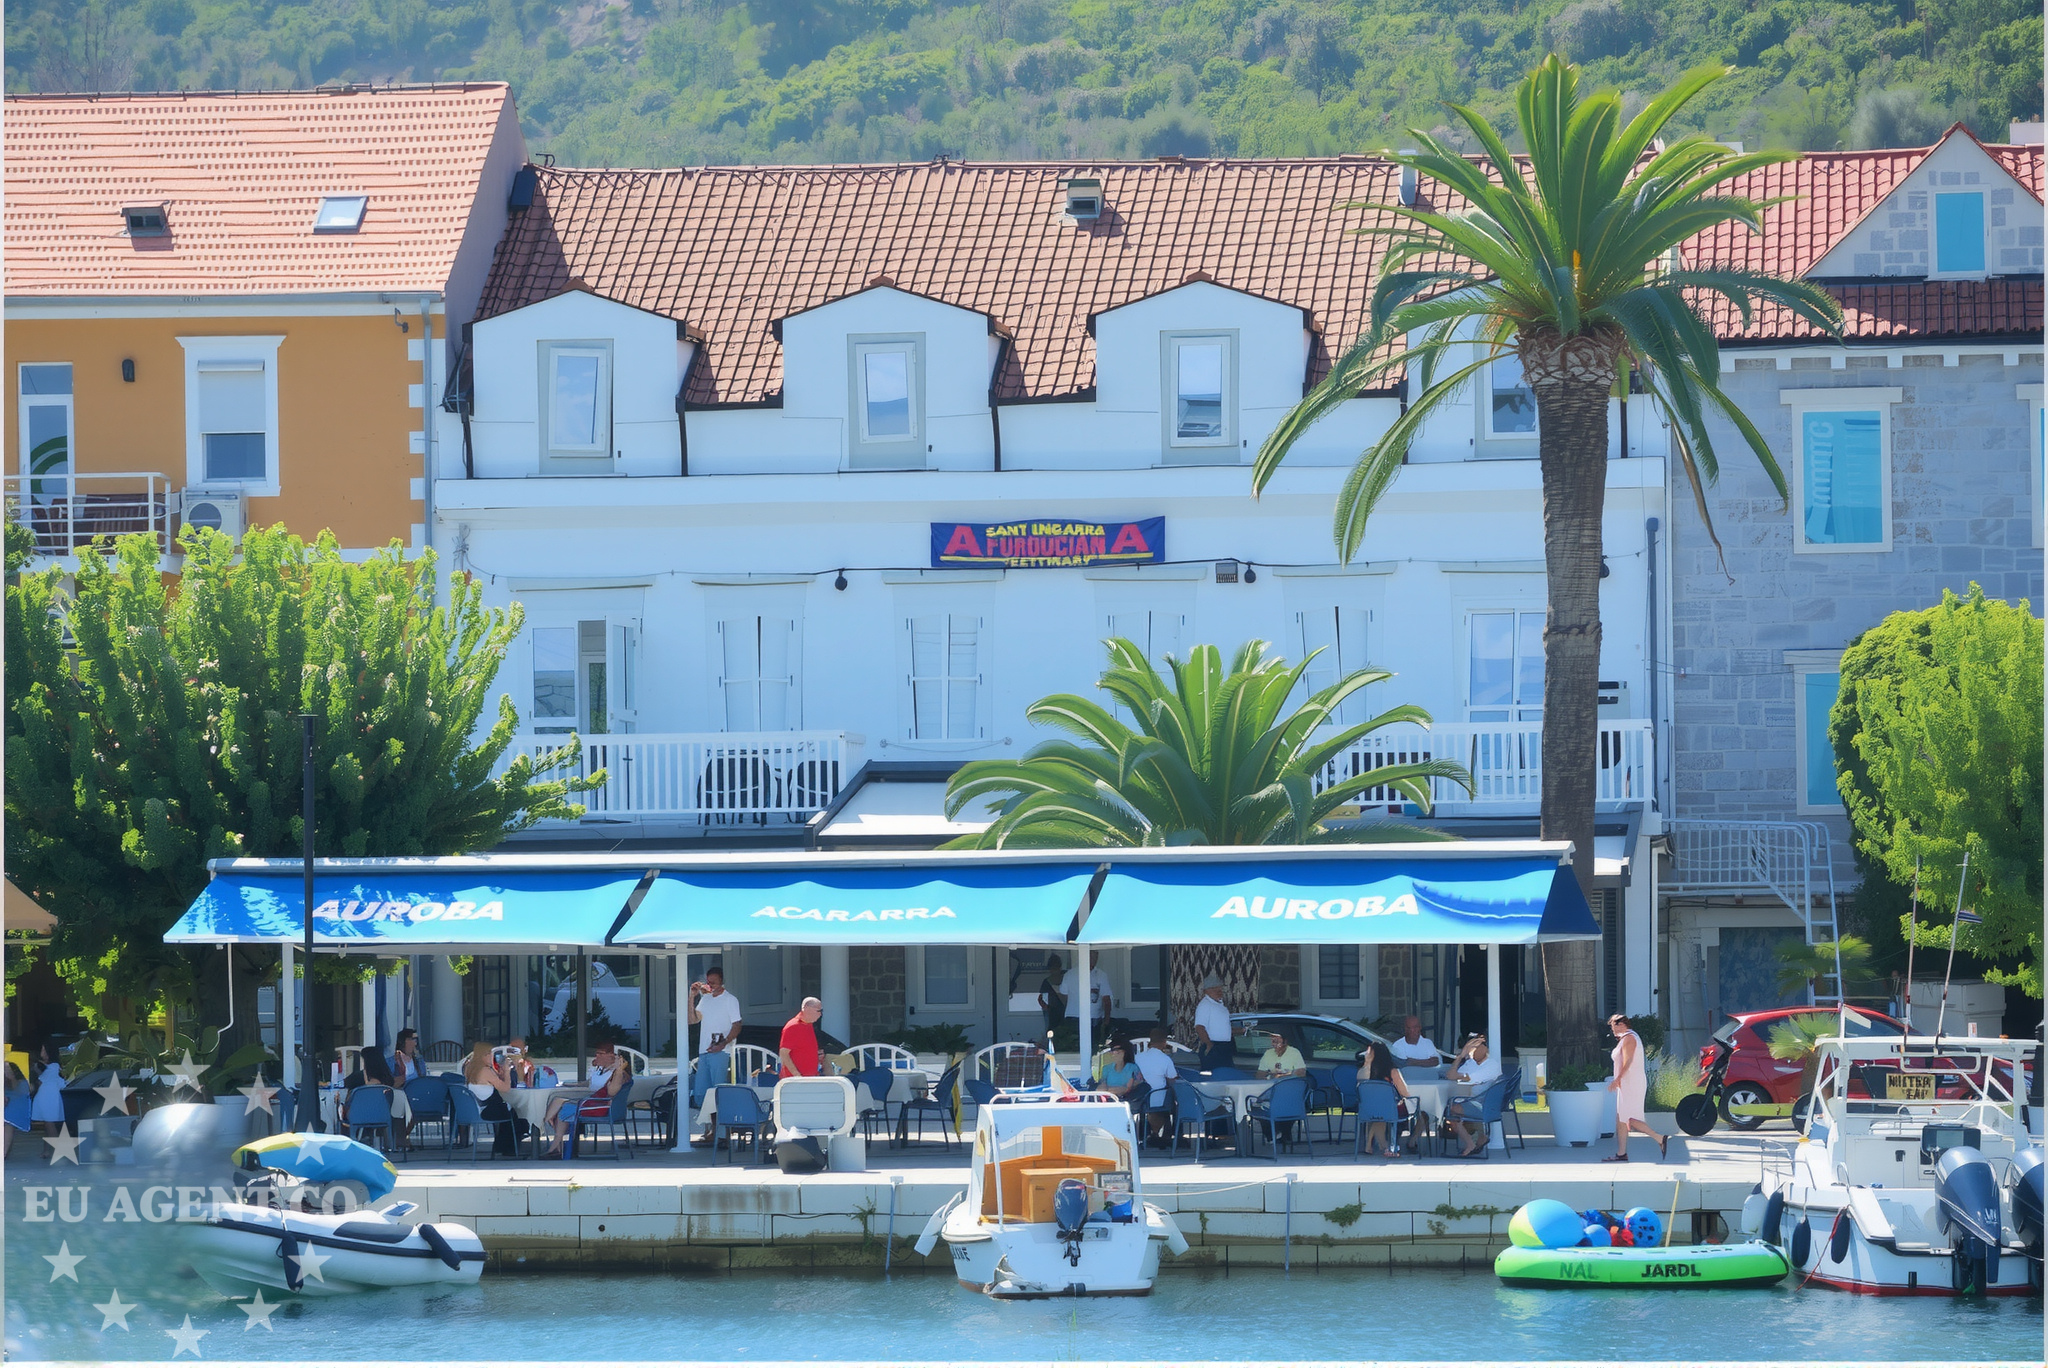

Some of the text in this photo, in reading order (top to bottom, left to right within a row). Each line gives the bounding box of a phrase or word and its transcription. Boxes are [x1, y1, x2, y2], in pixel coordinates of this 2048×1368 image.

[986, 523, 1027, 536] SANT
[944, 525, 983, 556] A
[1110, 524, 1149, 553] A
[312, 899, 504, 922] AUROBA
[750, 905, 957, 922] ACARARRA
[1210, 893, 1419, 920] AUROBA
[1559, 1262, 1701, 1279] NAL JARDL
